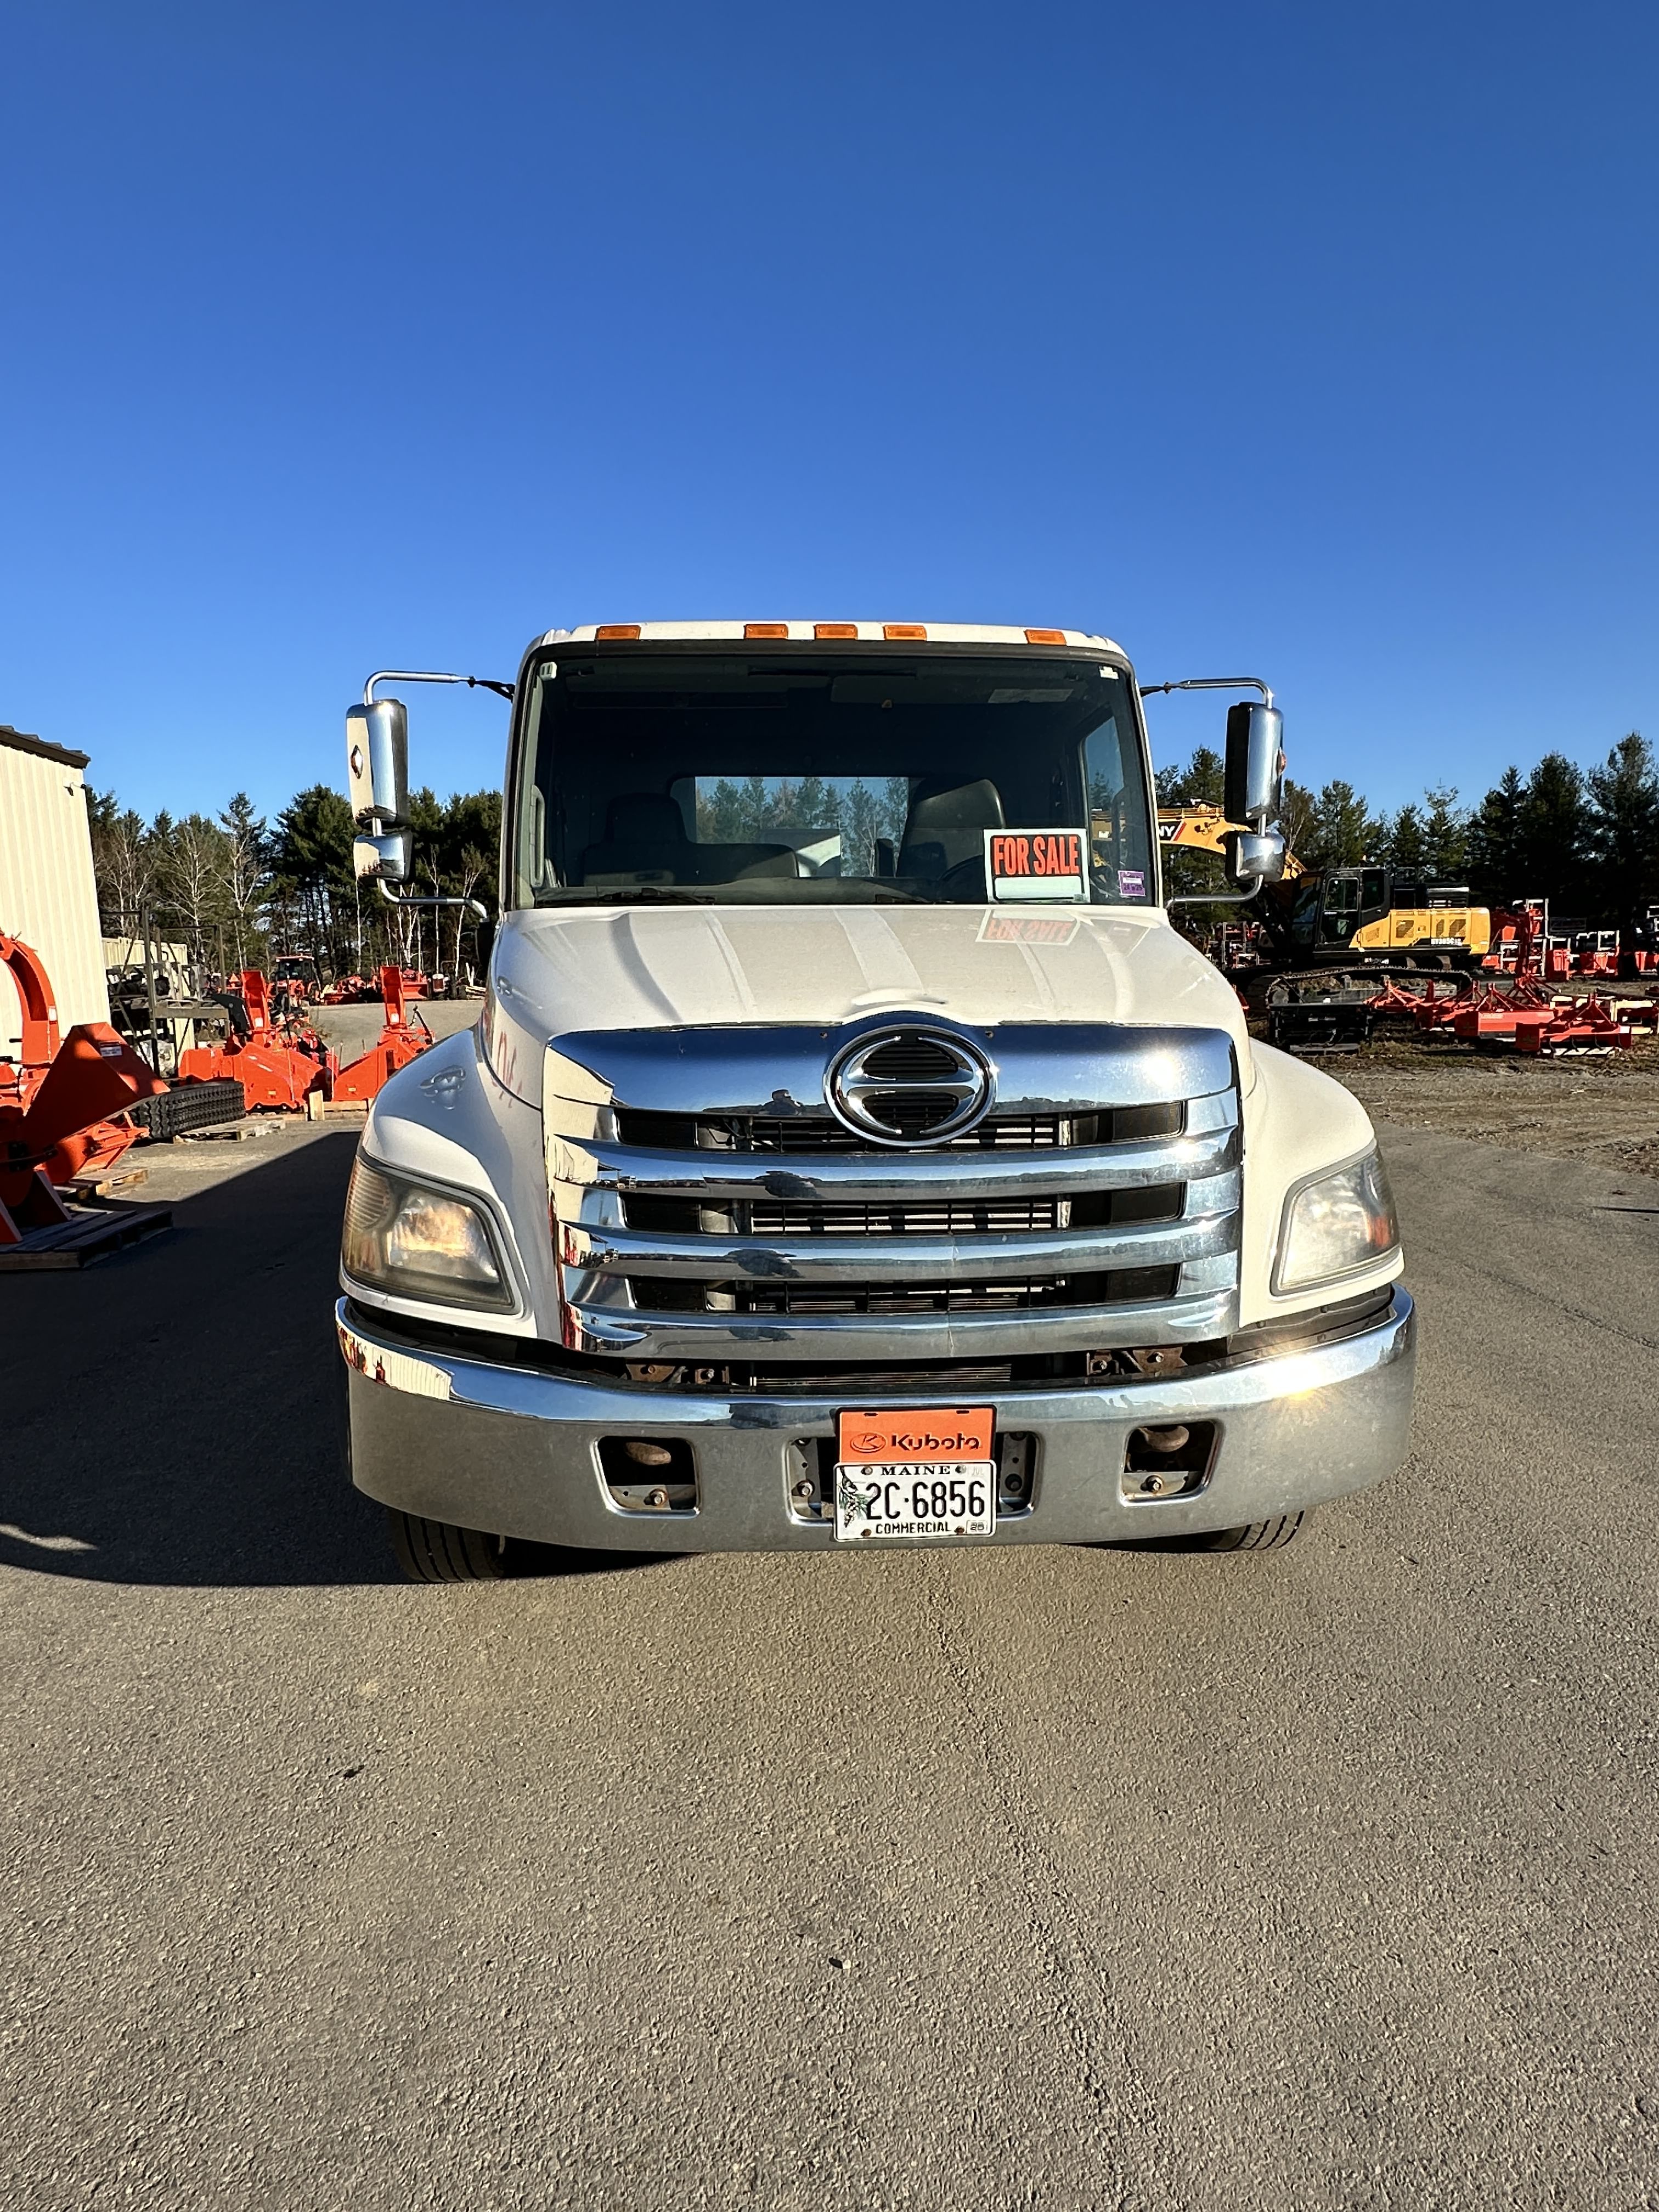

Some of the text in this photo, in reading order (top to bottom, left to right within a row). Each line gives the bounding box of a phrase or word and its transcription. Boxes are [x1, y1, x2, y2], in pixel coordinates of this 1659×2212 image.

[1159, 825, 1175, 837] NY
[994, 836, 1080, 876] FOR SALE
[891, 1433, 980, 1451] Kubota
[881, 1465, 950, 1476] MAINE
[876, 1521, 951, 1534] COMMERCIAL
